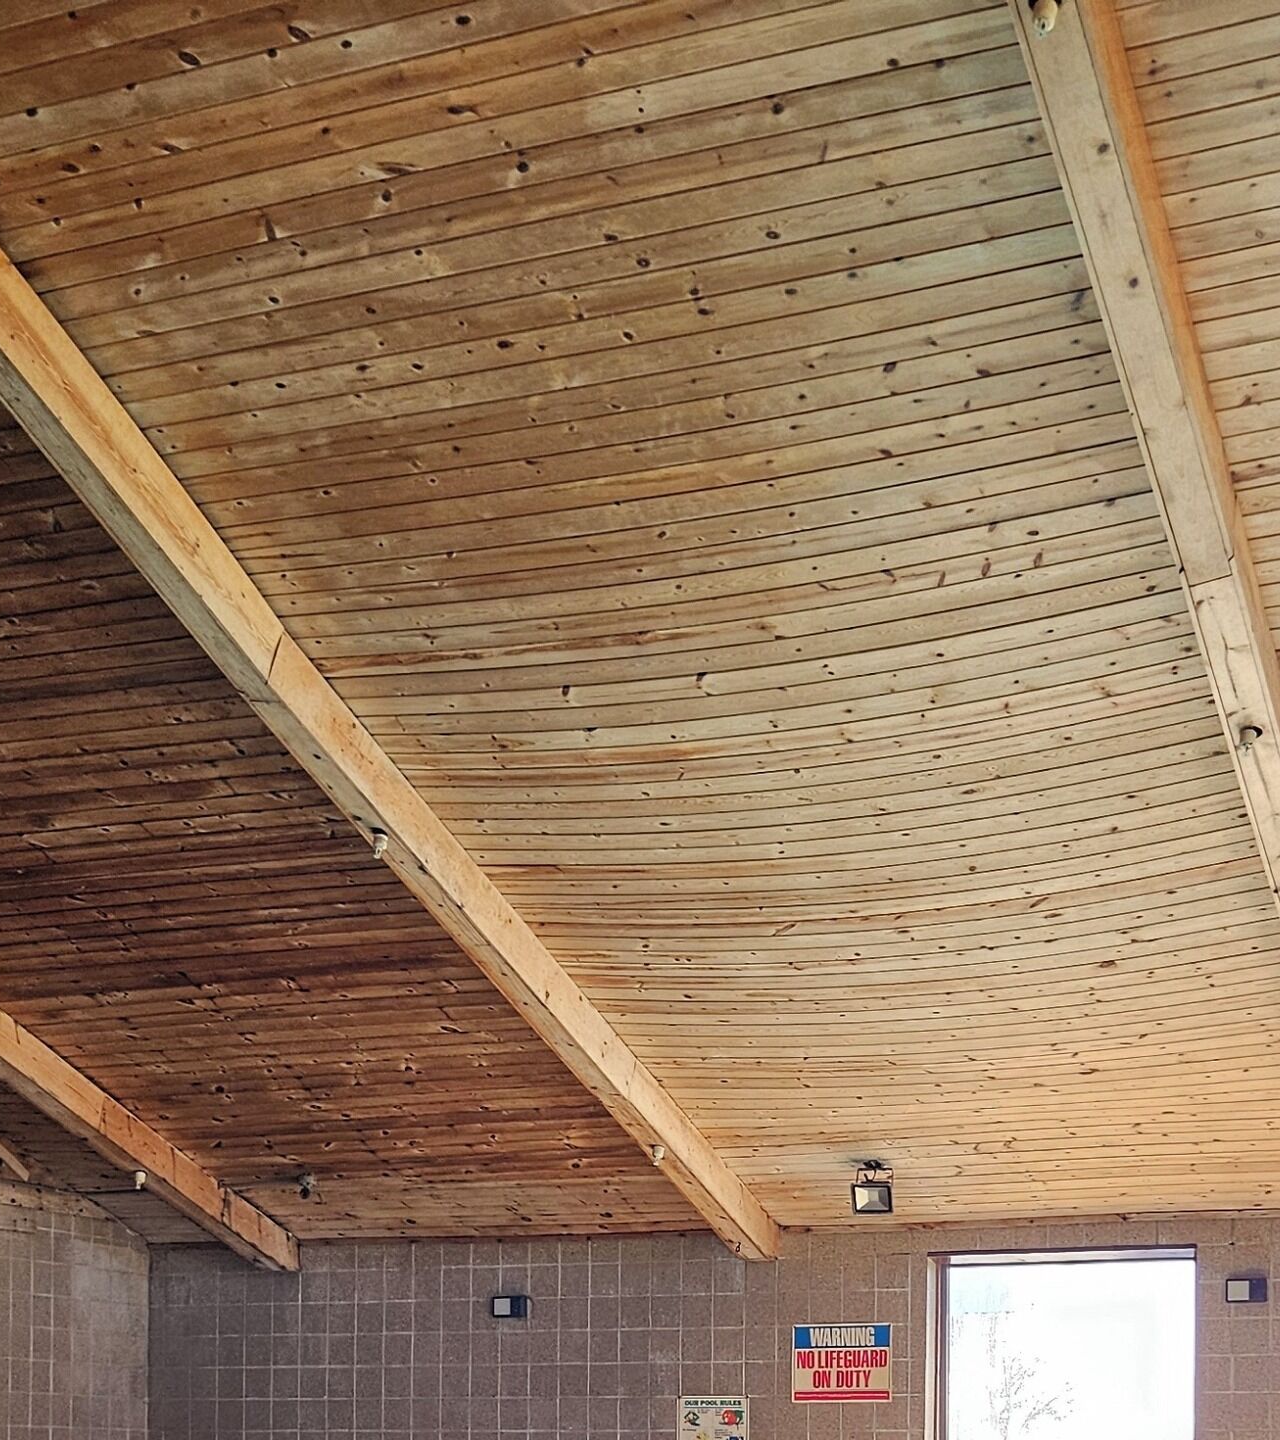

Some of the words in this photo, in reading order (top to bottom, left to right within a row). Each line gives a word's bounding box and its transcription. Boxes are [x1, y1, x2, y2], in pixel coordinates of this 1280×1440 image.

[809, 1327, 875, 1347] WARNING
[797, 1350, 815, 1369] NO
[818, 1349, 888, 1369] LIFEGUARD
[813, 1370, 831, 1388] ON
[836, 1370, 871, 1388] DUTY
